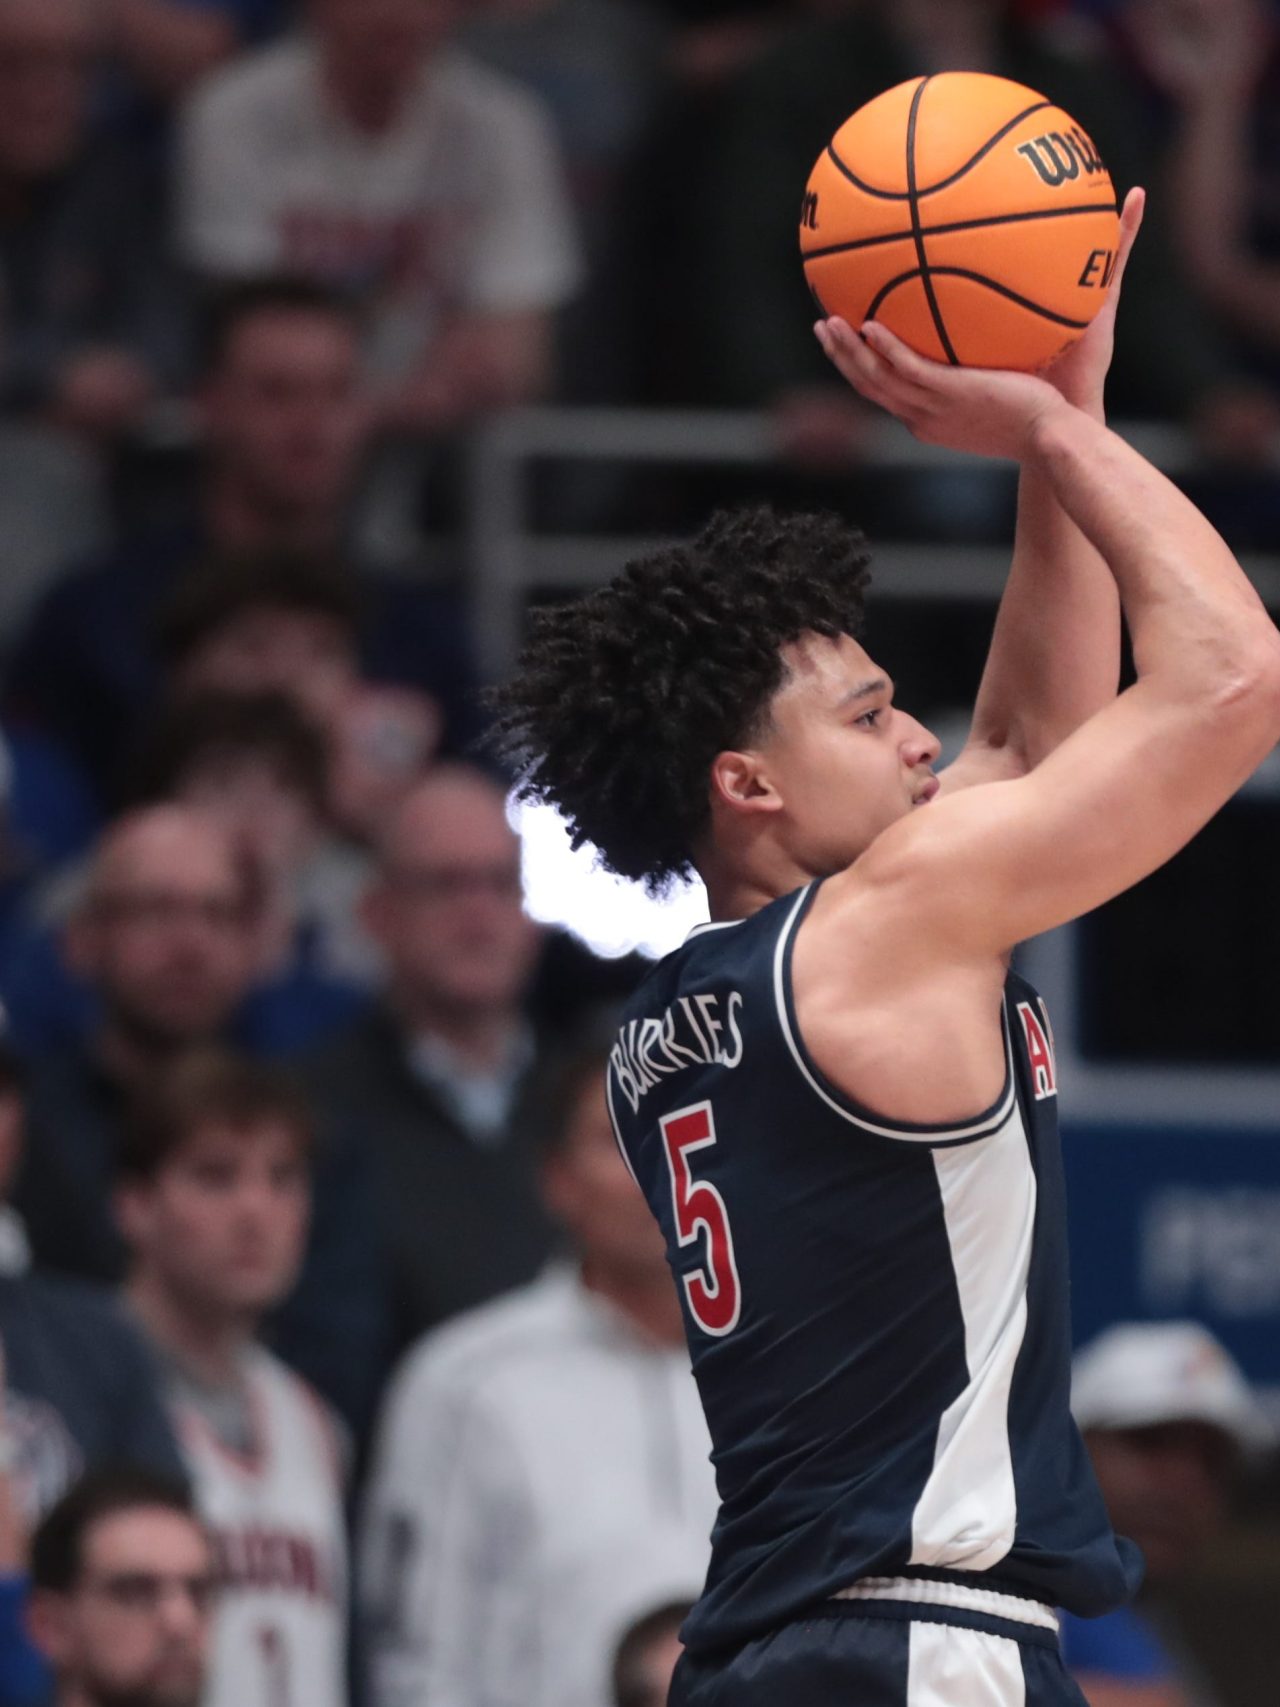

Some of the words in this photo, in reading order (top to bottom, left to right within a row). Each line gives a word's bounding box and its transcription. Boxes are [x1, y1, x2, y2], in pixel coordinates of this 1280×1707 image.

[1078, 248, 1117, 288] EV
[610, 991, 744, 1115] BURRIES
[658, 1099, 742, 1338] 5
